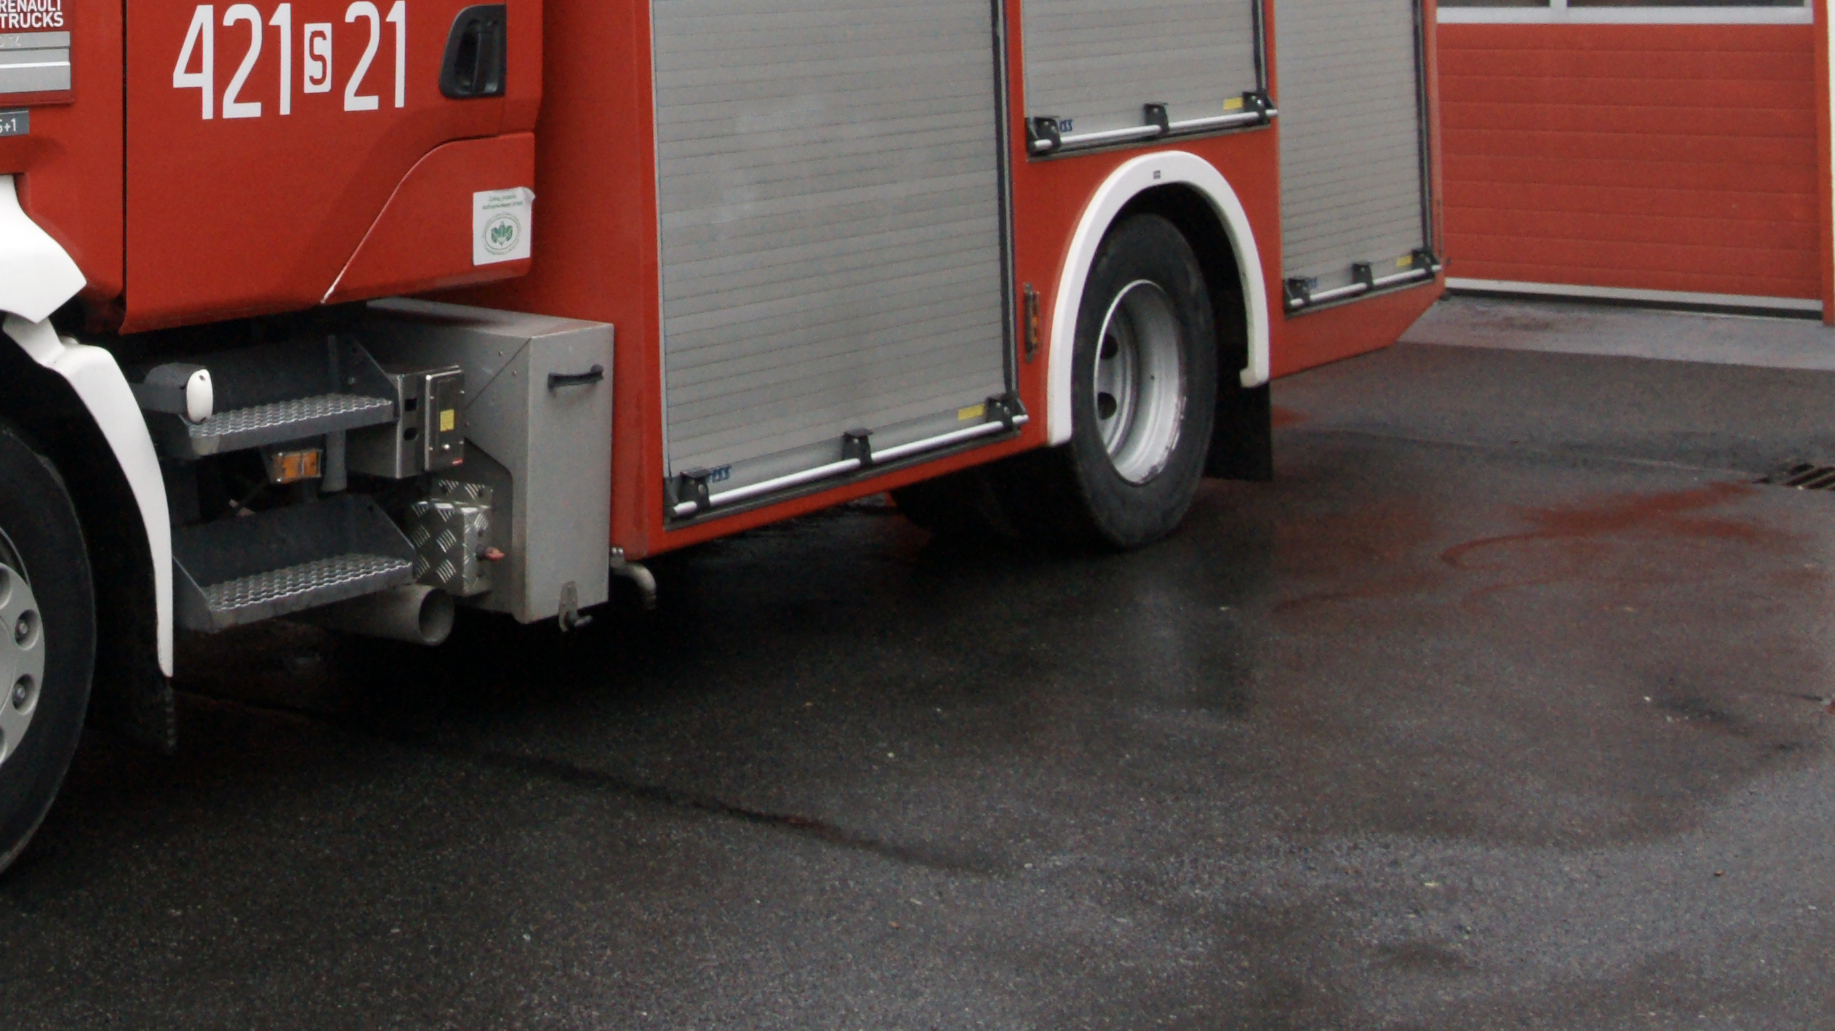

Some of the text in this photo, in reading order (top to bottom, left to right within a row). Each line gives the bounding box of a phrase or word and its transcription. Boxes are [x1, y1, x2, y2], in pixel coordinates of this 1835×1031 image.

[172, 0, 406, 120] 421 S 21
